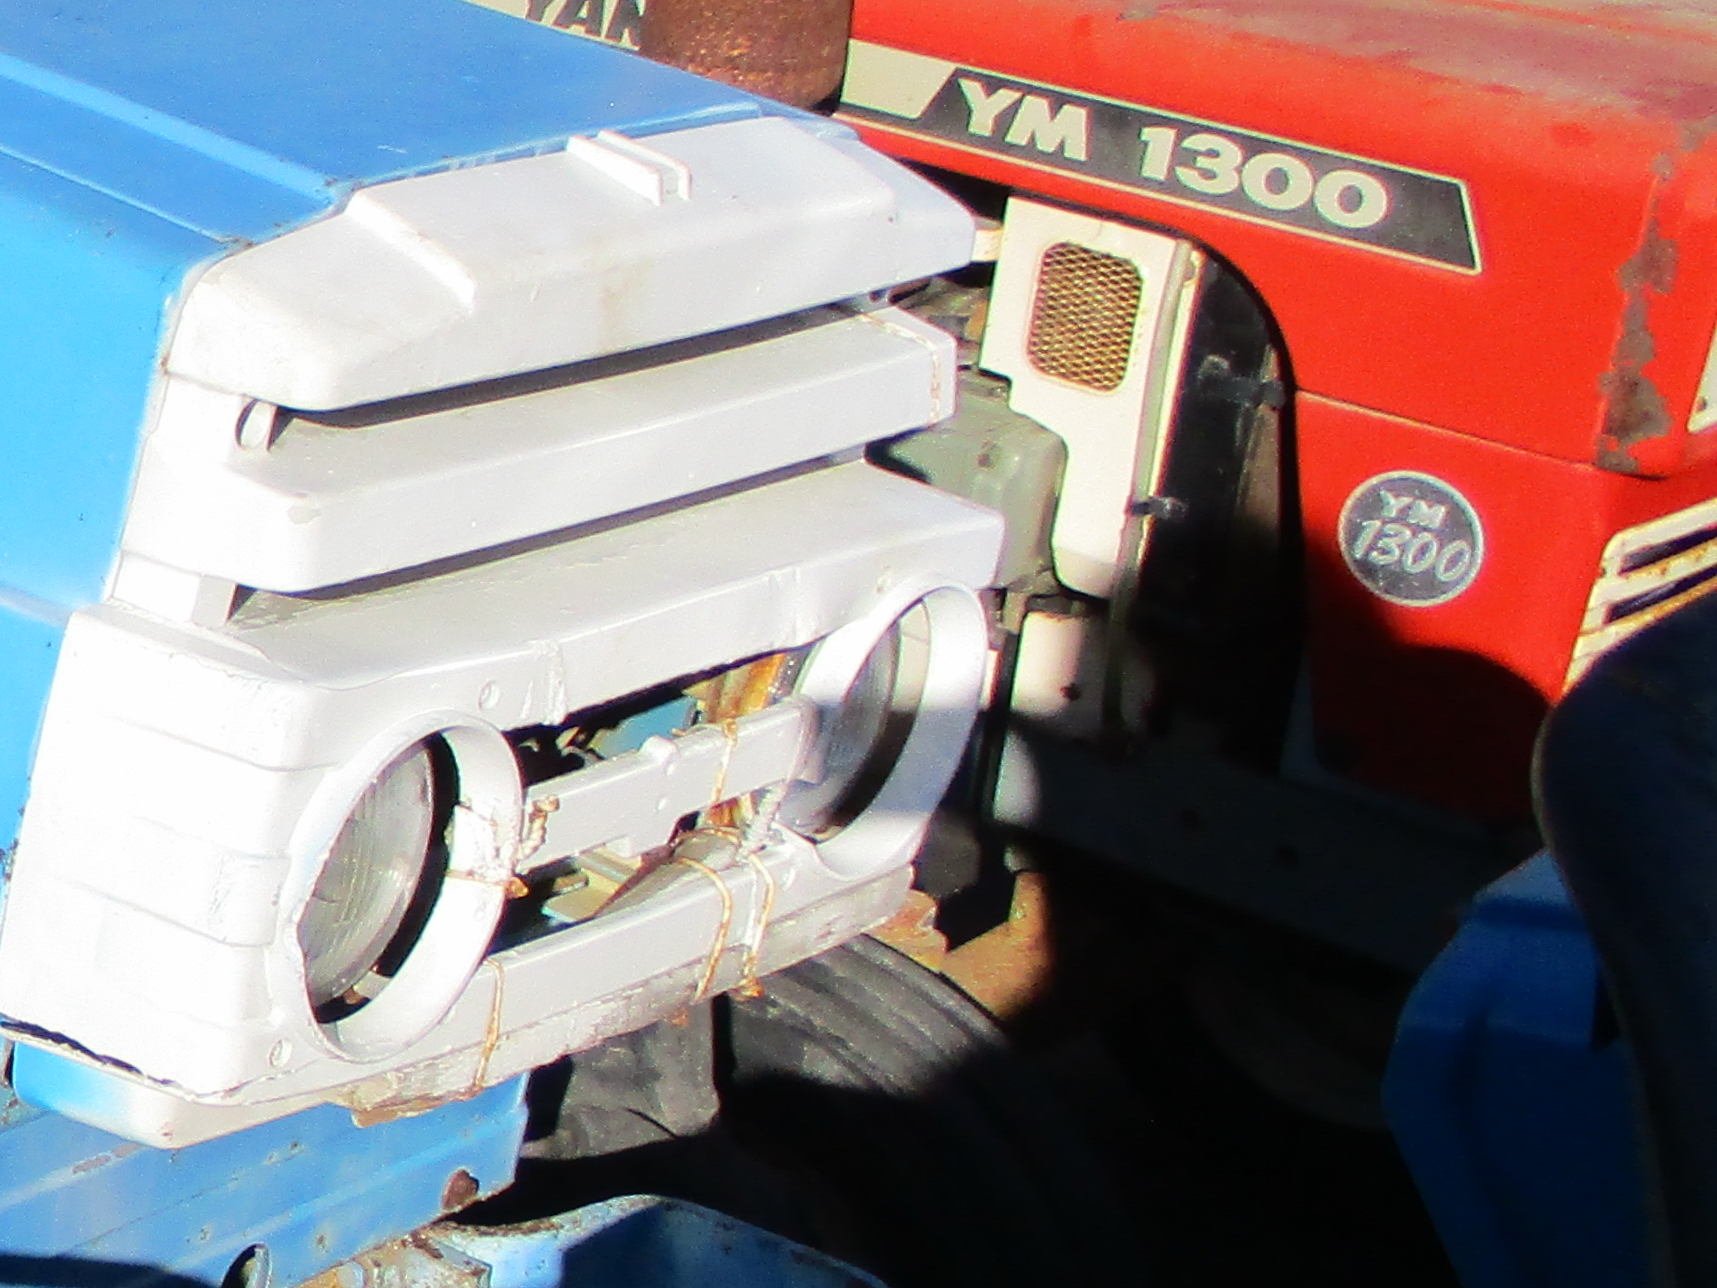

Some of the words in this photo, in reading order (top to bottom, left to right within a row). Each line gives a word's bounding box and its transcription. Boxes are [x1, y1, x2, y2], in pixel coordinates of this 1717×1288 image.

[957, 77, 1089, 163] YM
[1139, 126, 1390, 229] 1300
[1379, 489, 1446, 530] YM
[1353, 518, 1472, 582] 1300
